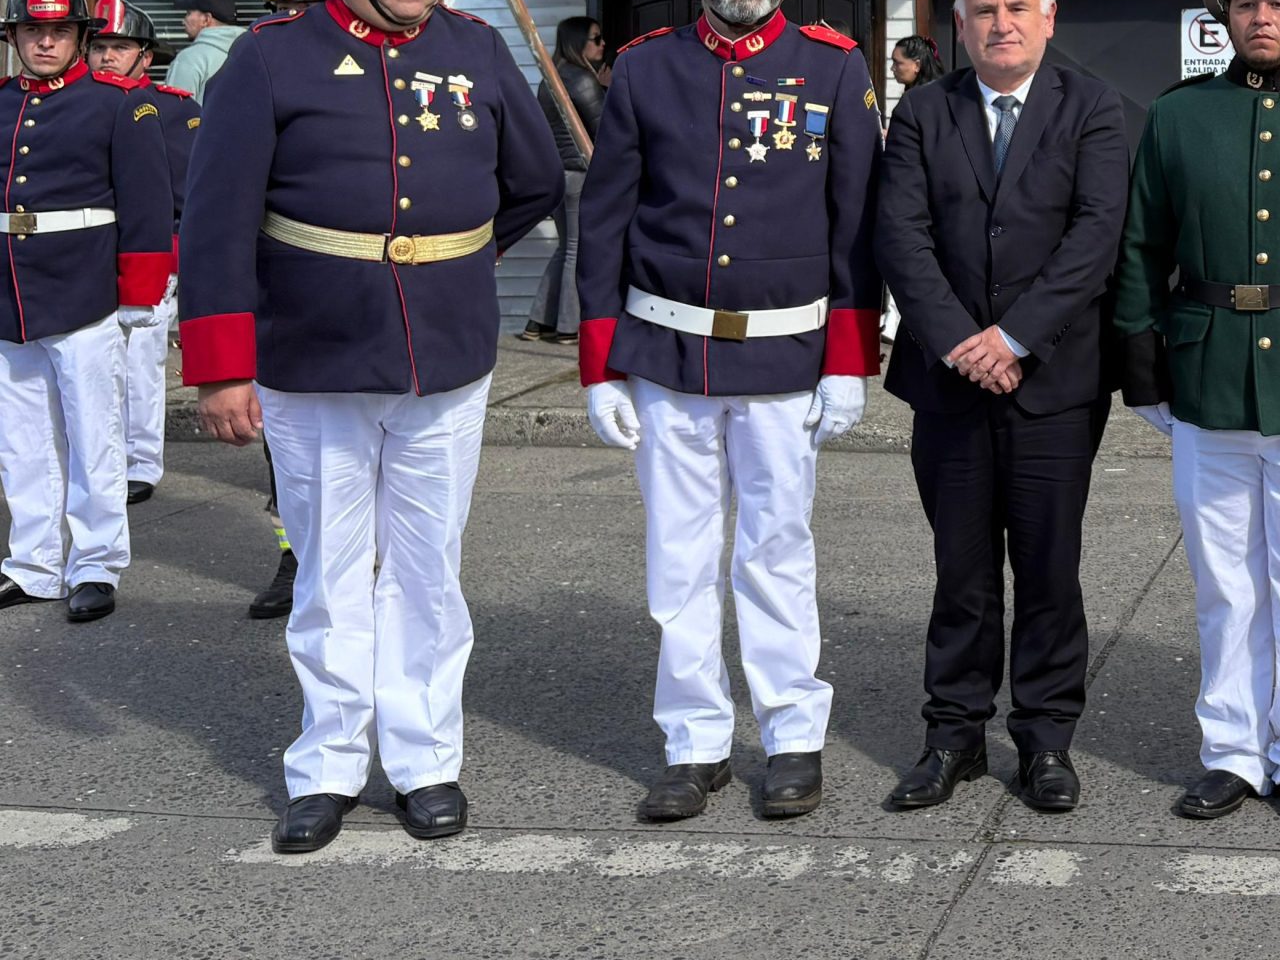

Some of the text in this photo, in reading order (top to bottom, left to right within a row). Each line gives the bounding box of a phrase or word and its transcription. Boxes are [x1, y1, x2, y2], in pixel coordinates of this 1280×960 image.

[1200, 19, 1222, 48] E
[1184, 58, 1227, 66] ENTRADA
[1186, 66, 1219, 74] SALIDA
